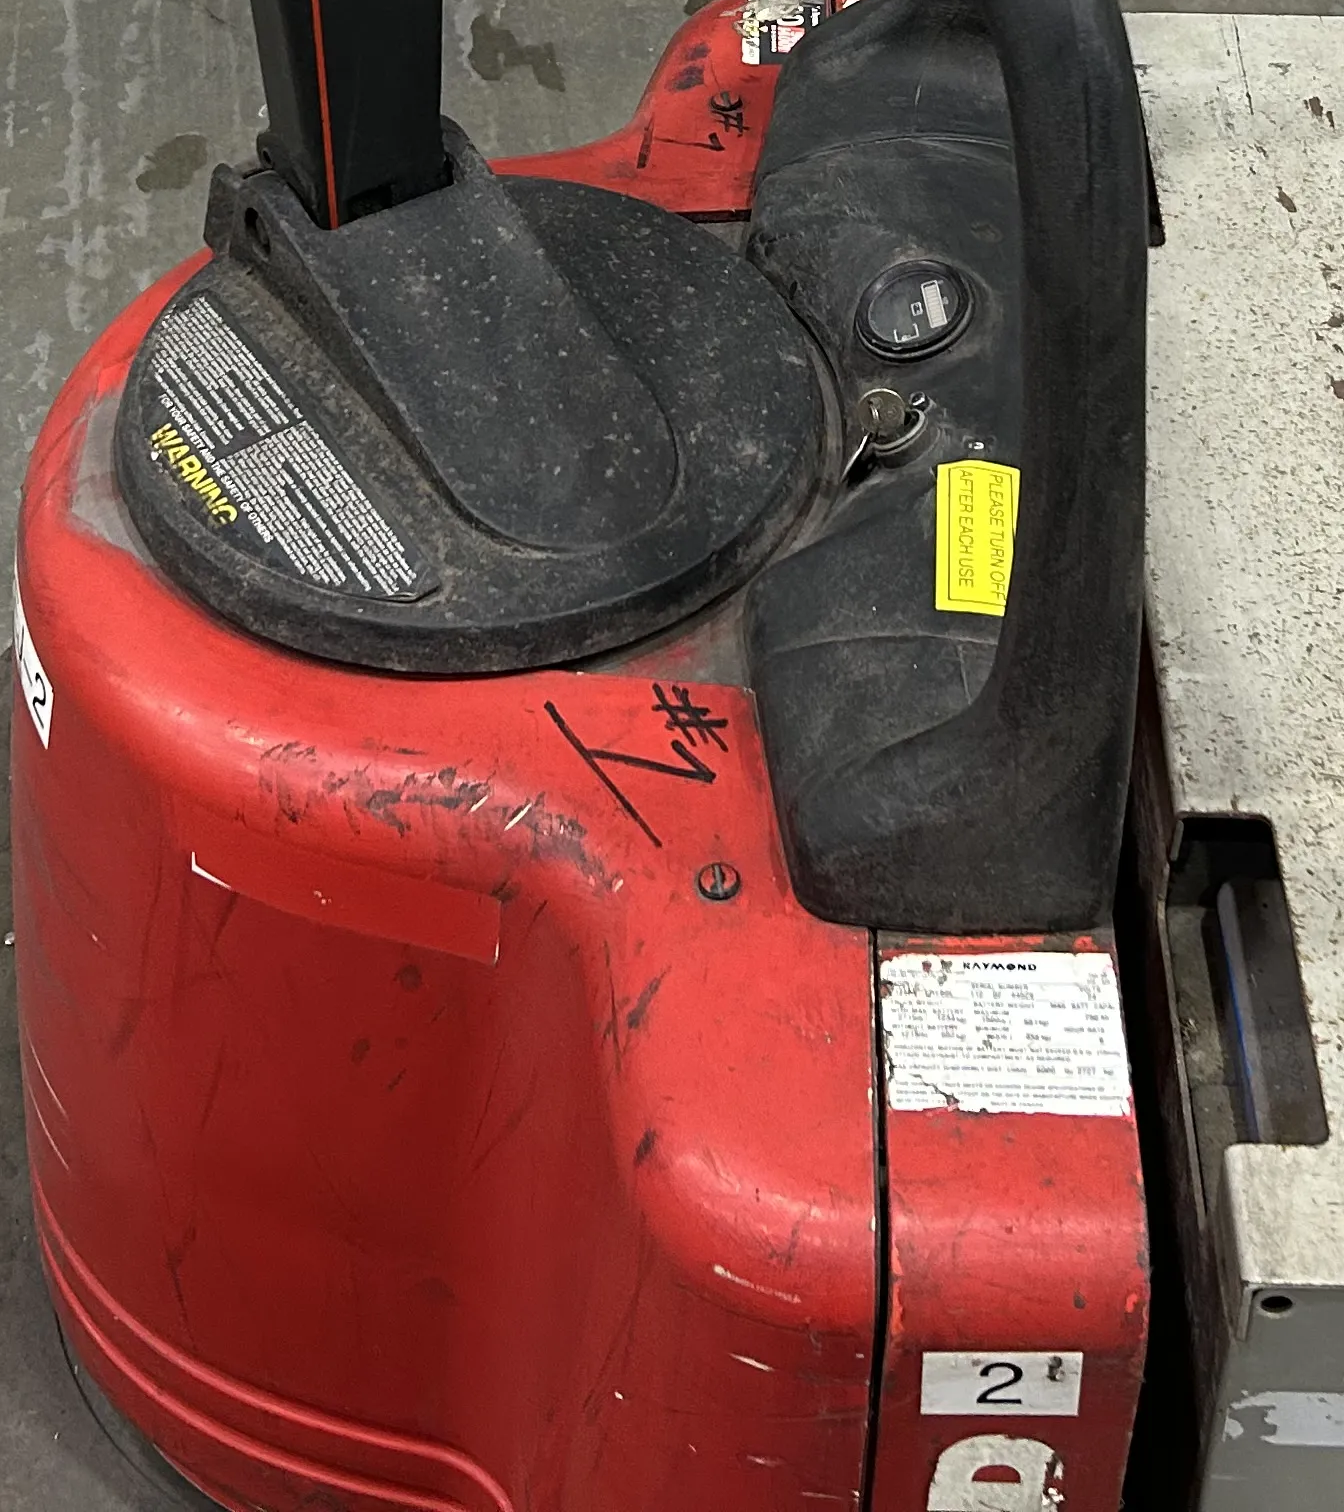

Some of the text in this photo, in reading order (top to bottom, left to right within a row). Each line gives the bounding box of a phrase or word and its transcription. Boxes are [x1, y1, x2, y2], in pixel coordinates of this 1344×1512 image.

[150, 422, 238, 526] WARNING
[959, 470, 974, 588] AFTER EACH USE
[989, 474, 1006, 601] PLEASE TURN OFF
[963, 961, 1037, 971] RAYMOND
[976, 1362, 1023, 1404] 2
